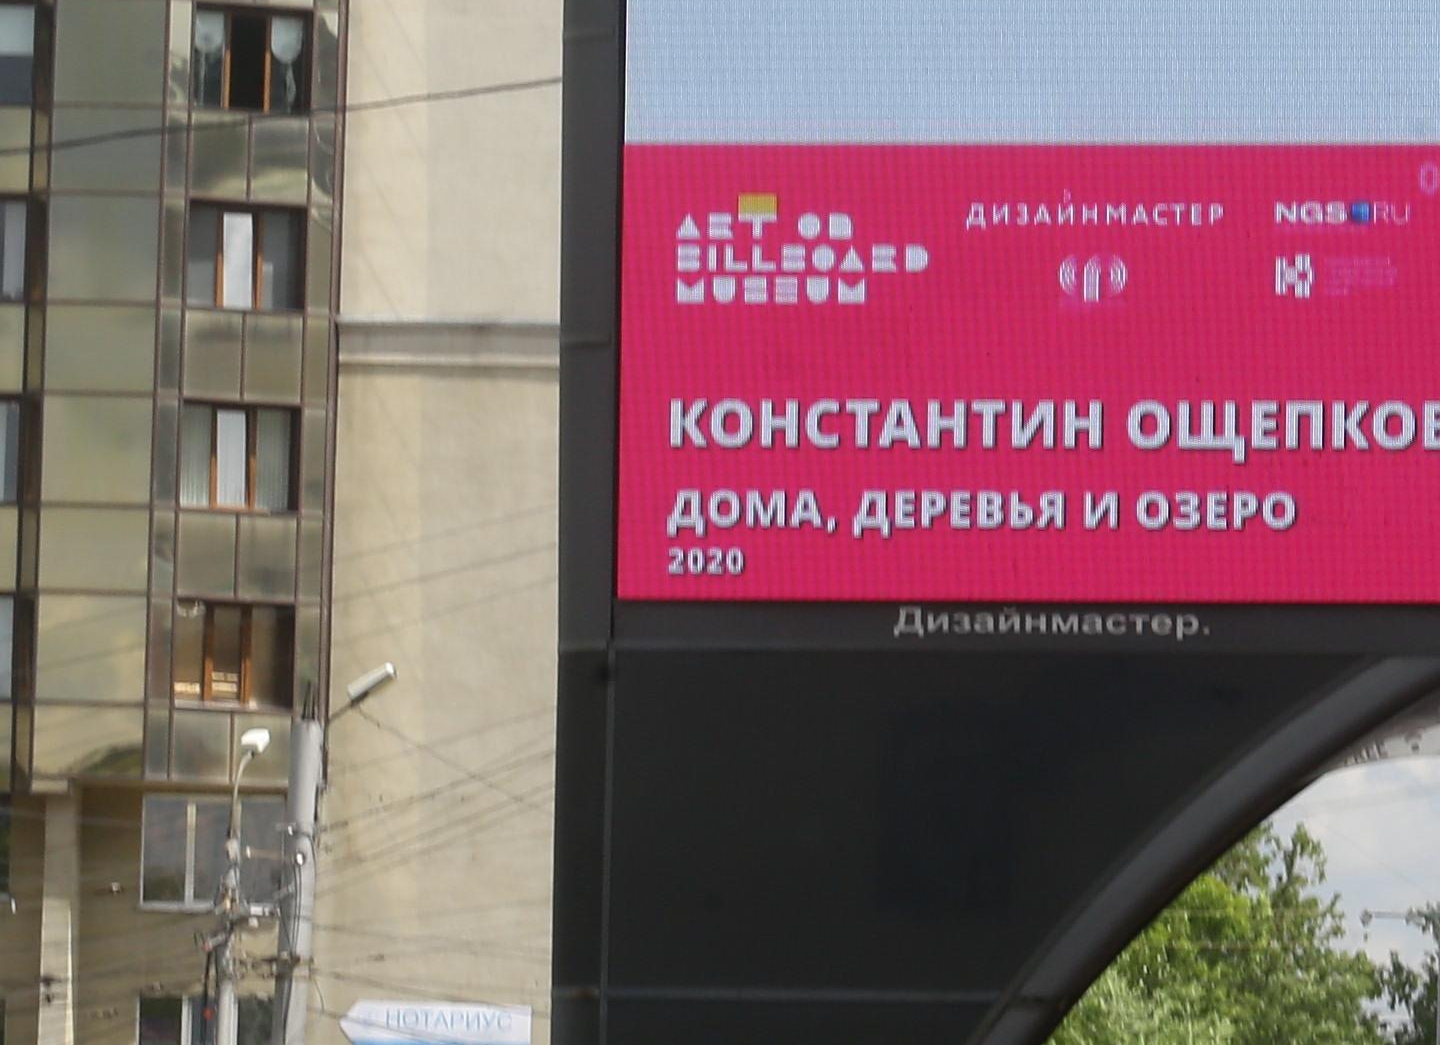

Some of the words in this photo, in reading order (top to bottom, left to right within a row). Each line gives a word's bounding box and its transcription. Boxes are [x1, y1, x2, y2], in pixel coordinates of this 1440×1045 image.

[966, 192, 1224, 230] ДИЗАЙНМАСТЕР
[676, 275, 866, 305] MUSEUM
[669, 397, 1104, 450] КОНСТАНТИН
[666, 488, 838, 538] ДОМА,
[852, 488, 1067, 538] ДЕРЕВЬЯ
[1082, 490, 1119, 531] И
[1135, 490, 1298, 531] ОЗЕРО
[666, 547, 745, 576] 2020
[893, 606, 1211, 641] Дизайнмастер.
[385, 1008, 512, 1033] НОТАРИУС
